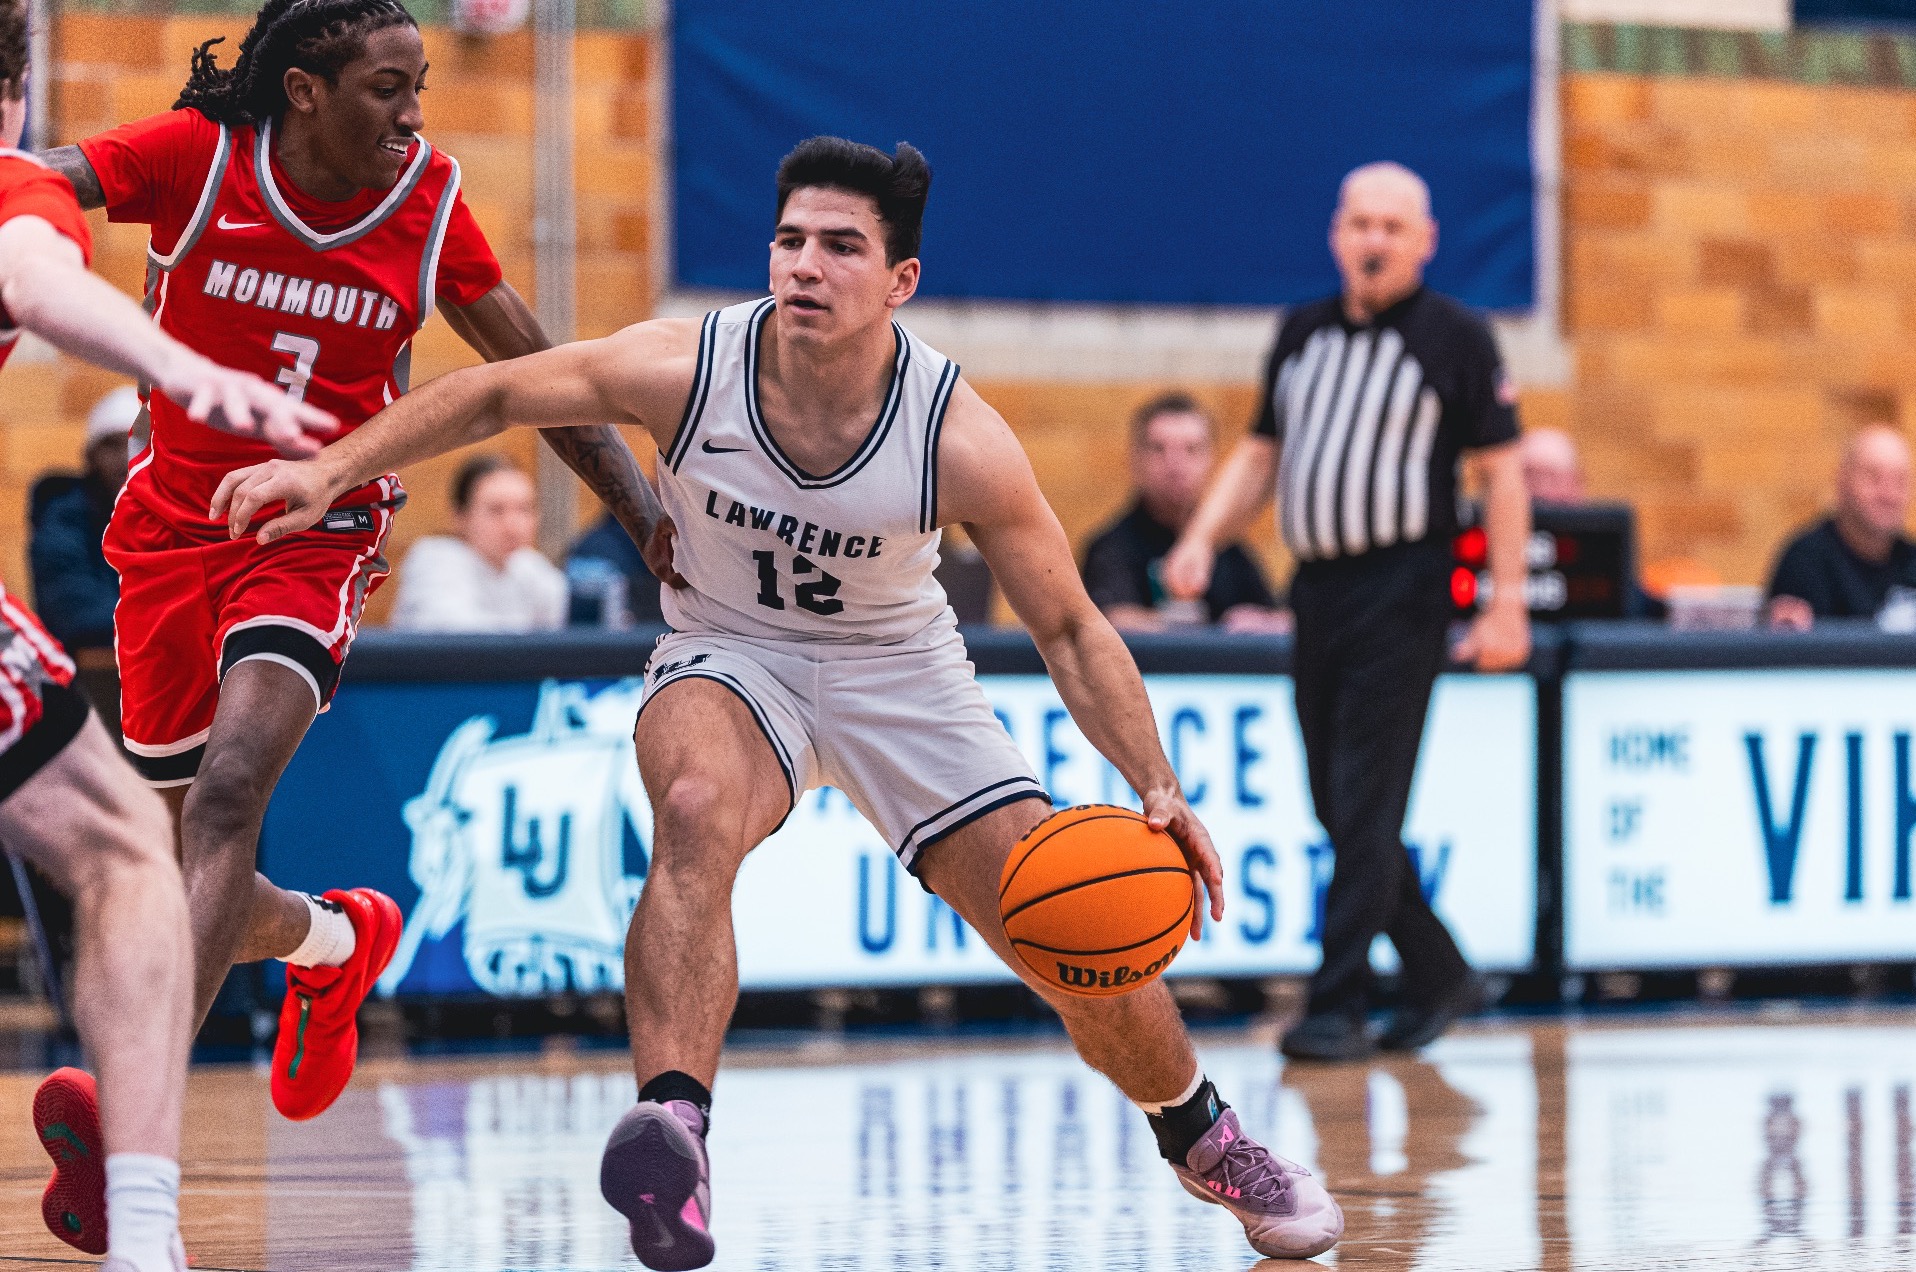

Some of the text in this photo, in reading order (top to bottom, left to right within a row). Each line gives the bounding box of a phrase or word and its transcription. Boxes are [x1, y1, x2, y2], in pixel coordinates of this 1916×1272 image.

[202, 259, 400, 330] MONMOUTH
[270, 330, 321, 403] 3
[705, 489, 887, 559] LAWRENCE
[752, 549, 844, 616] 12
[1056, 944, 1178, 988] Wilson
